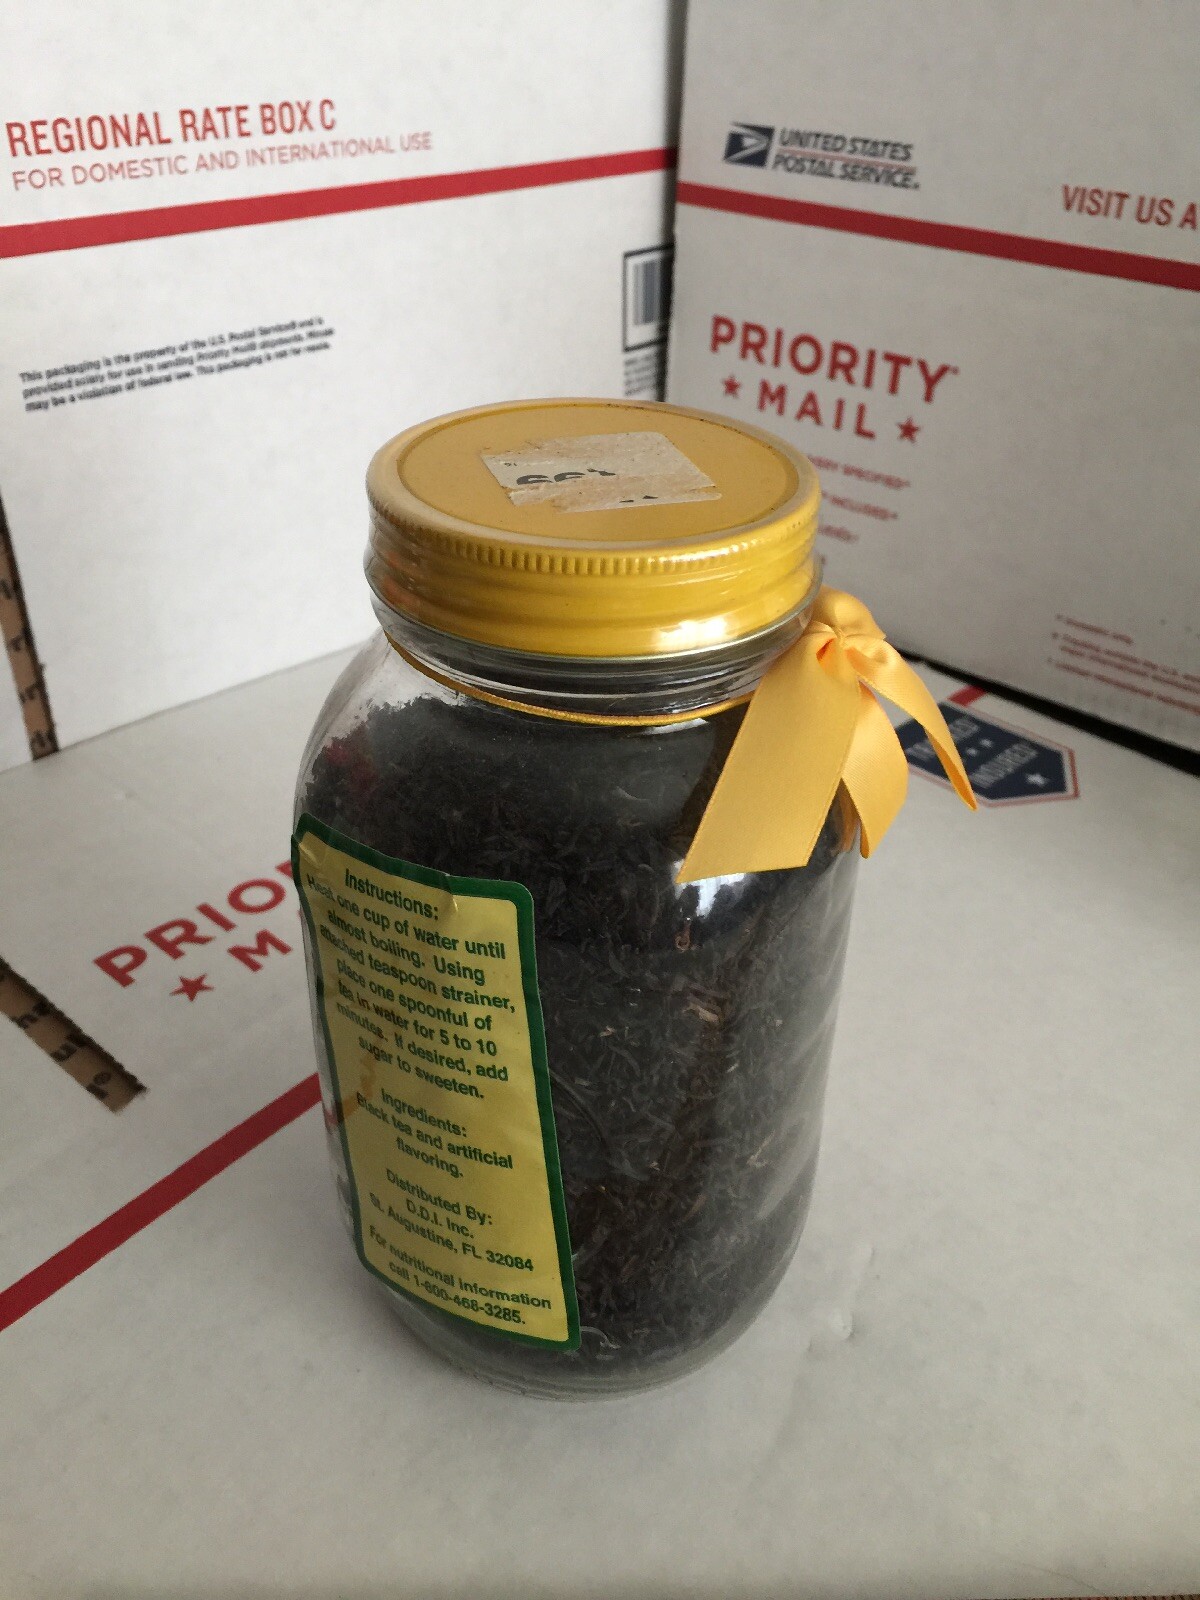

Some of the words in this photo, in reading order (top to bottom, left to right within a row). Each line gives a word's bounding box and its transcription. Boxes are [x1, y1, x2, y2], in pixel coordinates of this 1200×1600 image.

[6, 111, 172, 157] REGIONAL
[178, 104, 253, 143] RATE
[260, 99, 314, 136] BOX
[321, 98, 337, 130] C
[780, 127, 847, 152] UNITED
[848, 135, 914, 162] STATES
[12, 166, 65, 191] FOR
[72, 153, 188, 186] DOMESTIC
[195, 149, 241, 173] AND
[245, 135, 396, 168] INTERNATIONAL
[400, 131, 433, 152] USE
[772, 153, 835, 178] POSTAL
[1061, 184, 1130, 219] VISIT
[1135, 195, 1175, 226] US
[709, 314, 952, 404] PRIORITY
[757, 378, 876, 440] MAIL
[92, 860, 294, 988] PRIO
[345, 868, 440, 920] Instructions:
[327, 909, 368, 945] almost
[369, 930, 426, 969] boiling.
[433, 954, 486, 987] Using
[336, 895, 360, 917] one
[363, 907, 390, 932] cup
[394, 920, 409, 937] of
[413, 926, 460, 951] water
[464, 938, 506, 960] until
[336, 958, 366, 989] place
[369, 980, 395, 1001] one
[399, 993, 469, 1028] spoonful
[474, 1014, 493, 1032] of
[368, 953, 437, 995] teaspoon
[441, 984, 516, 1013] strainer,
[356, 991, 371, 1011] in
[372, 1002, 410, 1031] water
[413, 1016, 435, 1041] for
[440, 1029, 450, 1046] 5
[453, 1033, 472, 1054] to
[476, 1038, 498, 1057] 10
[358, 1036, 394, 1065] sugar
[397, 1054, 412, 1074] to
[415, 1068, 485, 1099] sweeten.
[394, 1031, 403, 1050] If
[407, 1040, 472, 1076] desired,
[476, 1063, 509, 1082] add
[356, 1091, 390, 1125] Black
[391, 1114, 413, 1137] tea
[416, 1129, 443, 1151] and
[447, 1142, 514, 1169] artificial
[381, 1088, 468, 1138] Ingredients:
[396, 1136, 464, 1179] flavoring.
[386, 1168, 461, 1216] Distributed
[465, 1204, 493, 1226] By:
[406, 1198, 443, 1227] D.D.I.
[446, 1217, 475, 1239] Inc.
[369, 1224, 388, 1249] For
[389, 1244, 455, 1288] nutritional
[387, 1205, 458, 1254] Augustine,
[461, 1242, 483, 1260] FL
[486, 1249, 534, 1272] 32084
[389, 1261, 411, 1282] call
